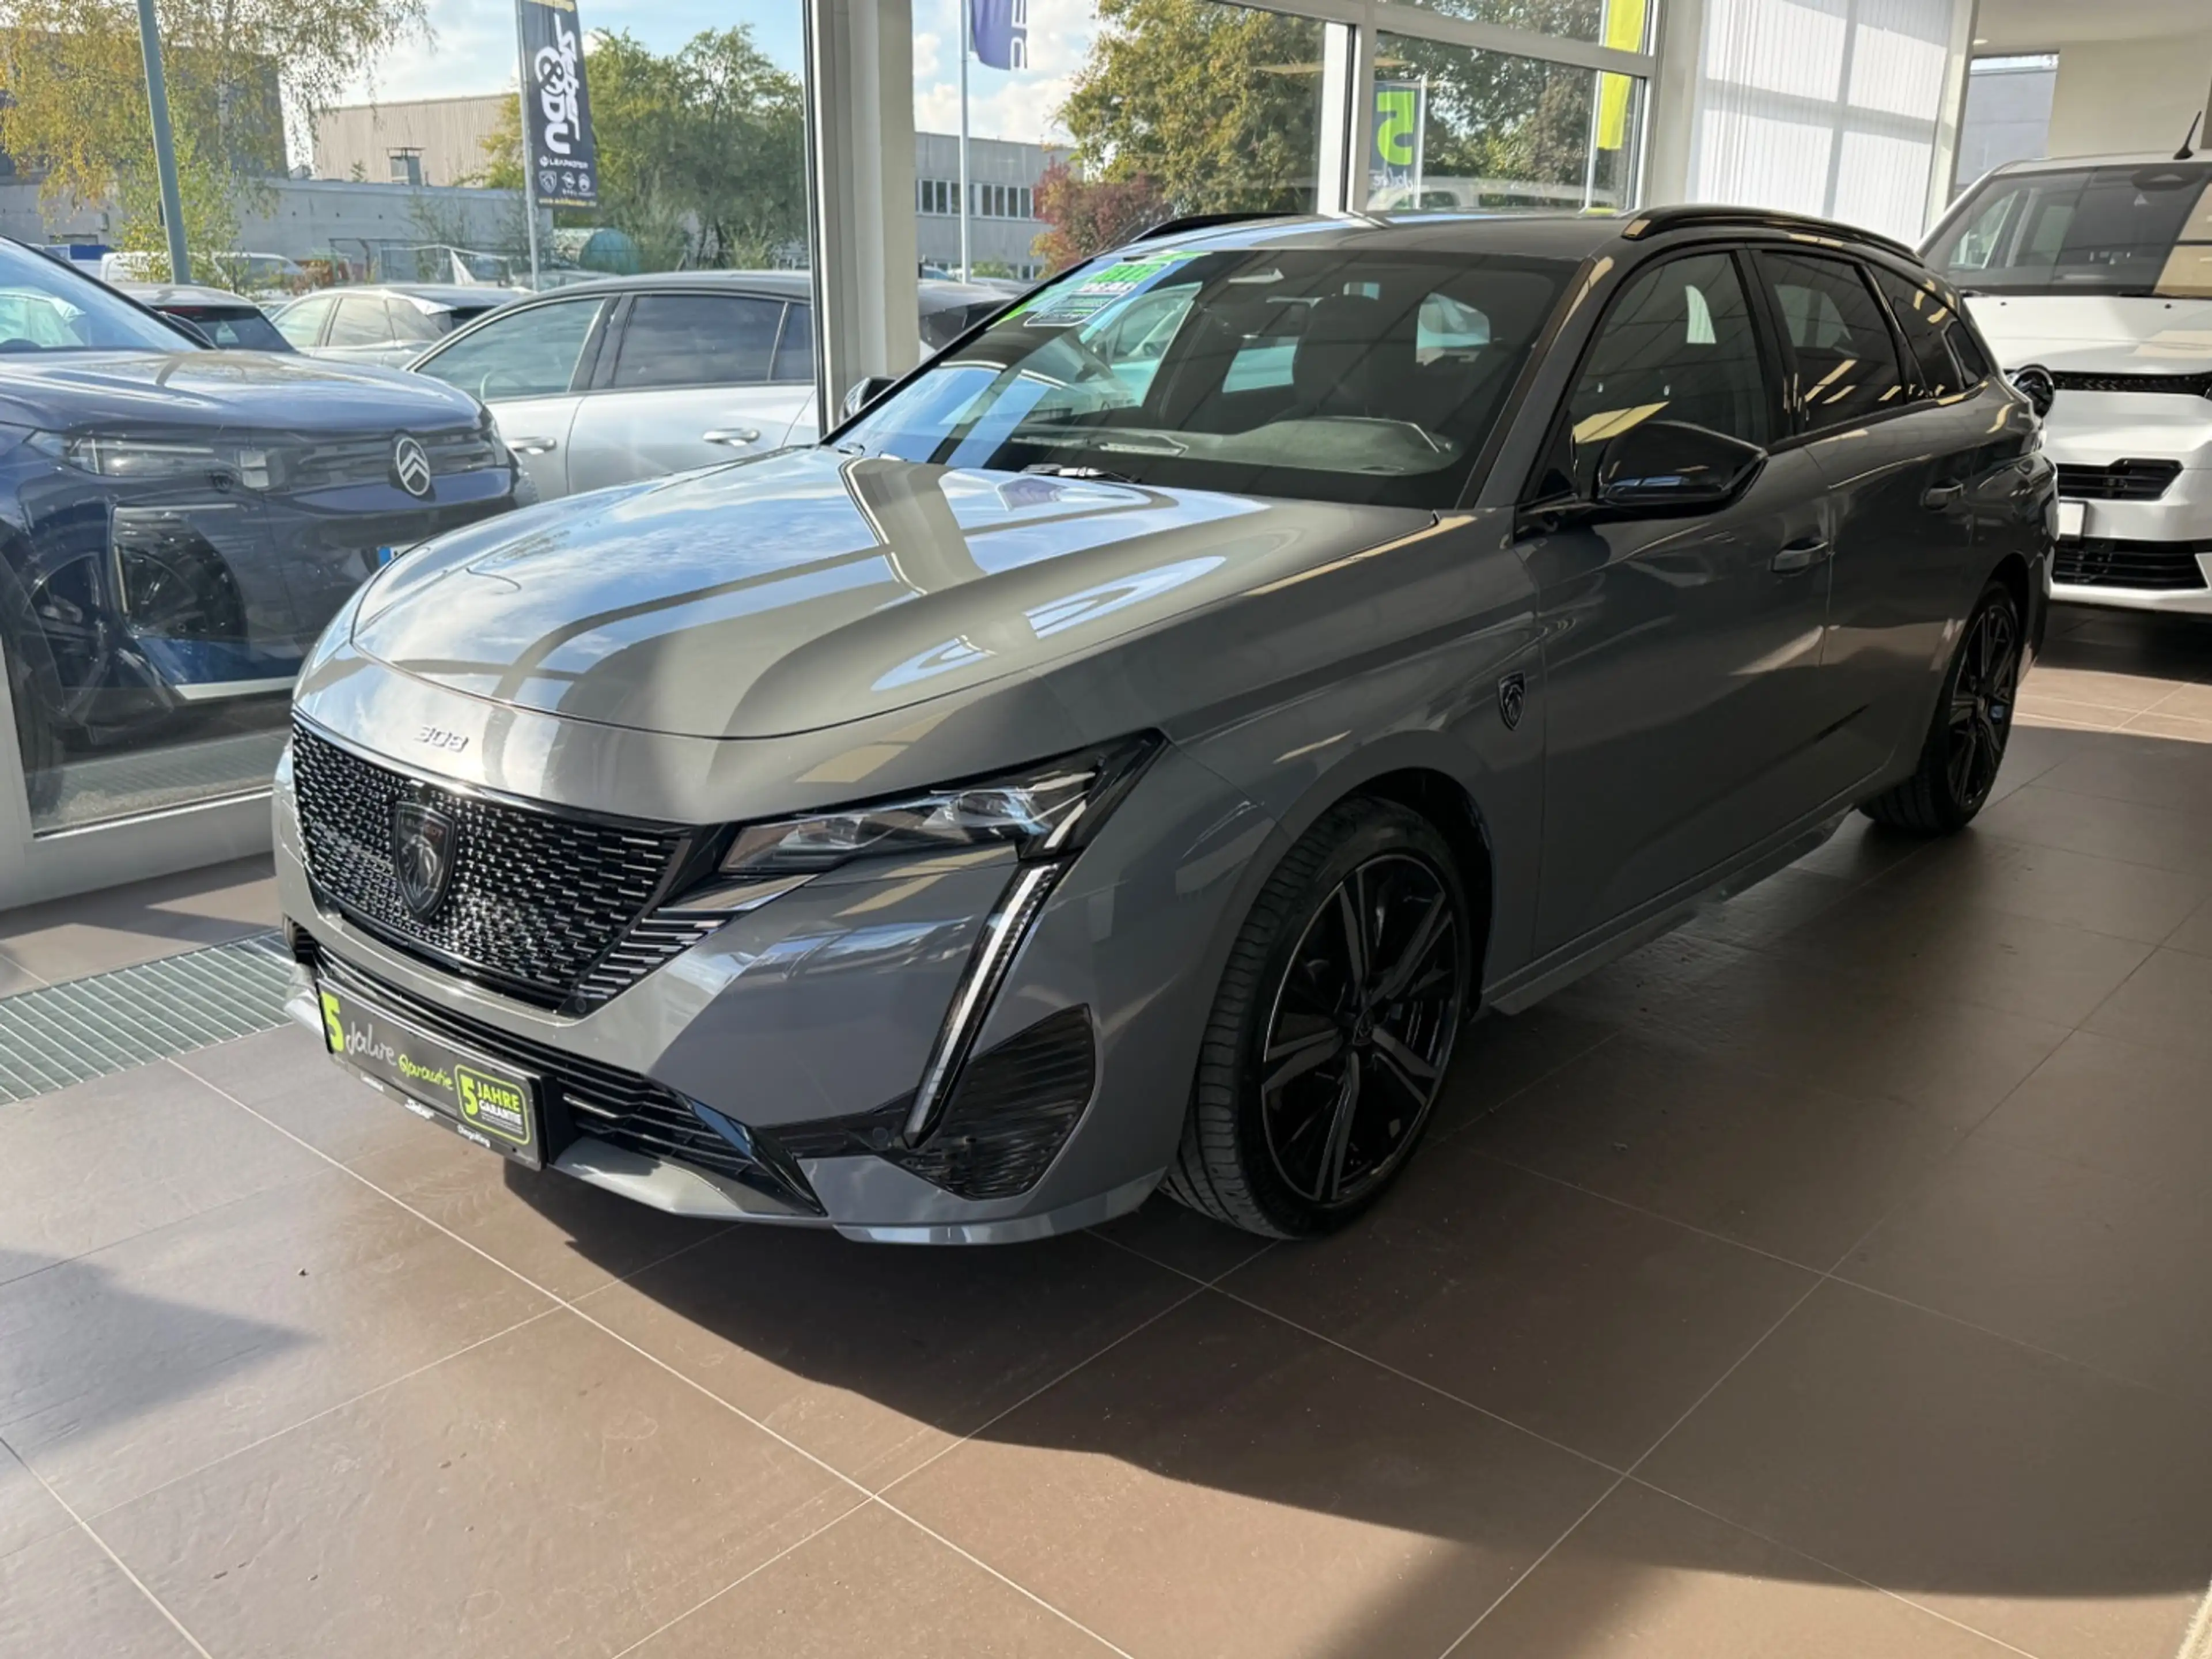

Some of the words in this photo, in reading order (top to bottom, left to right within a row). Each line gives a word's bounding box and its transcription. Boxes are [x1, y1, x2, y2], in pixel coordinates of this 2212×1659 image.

[540, 89, 571, 154] DU
[413, 725, 469, 753] 308
[321, 991, 344, 1052] 5
[460, 1074, 478, 1116] 5
[477, 1081, 520, 1113] JAHRE
